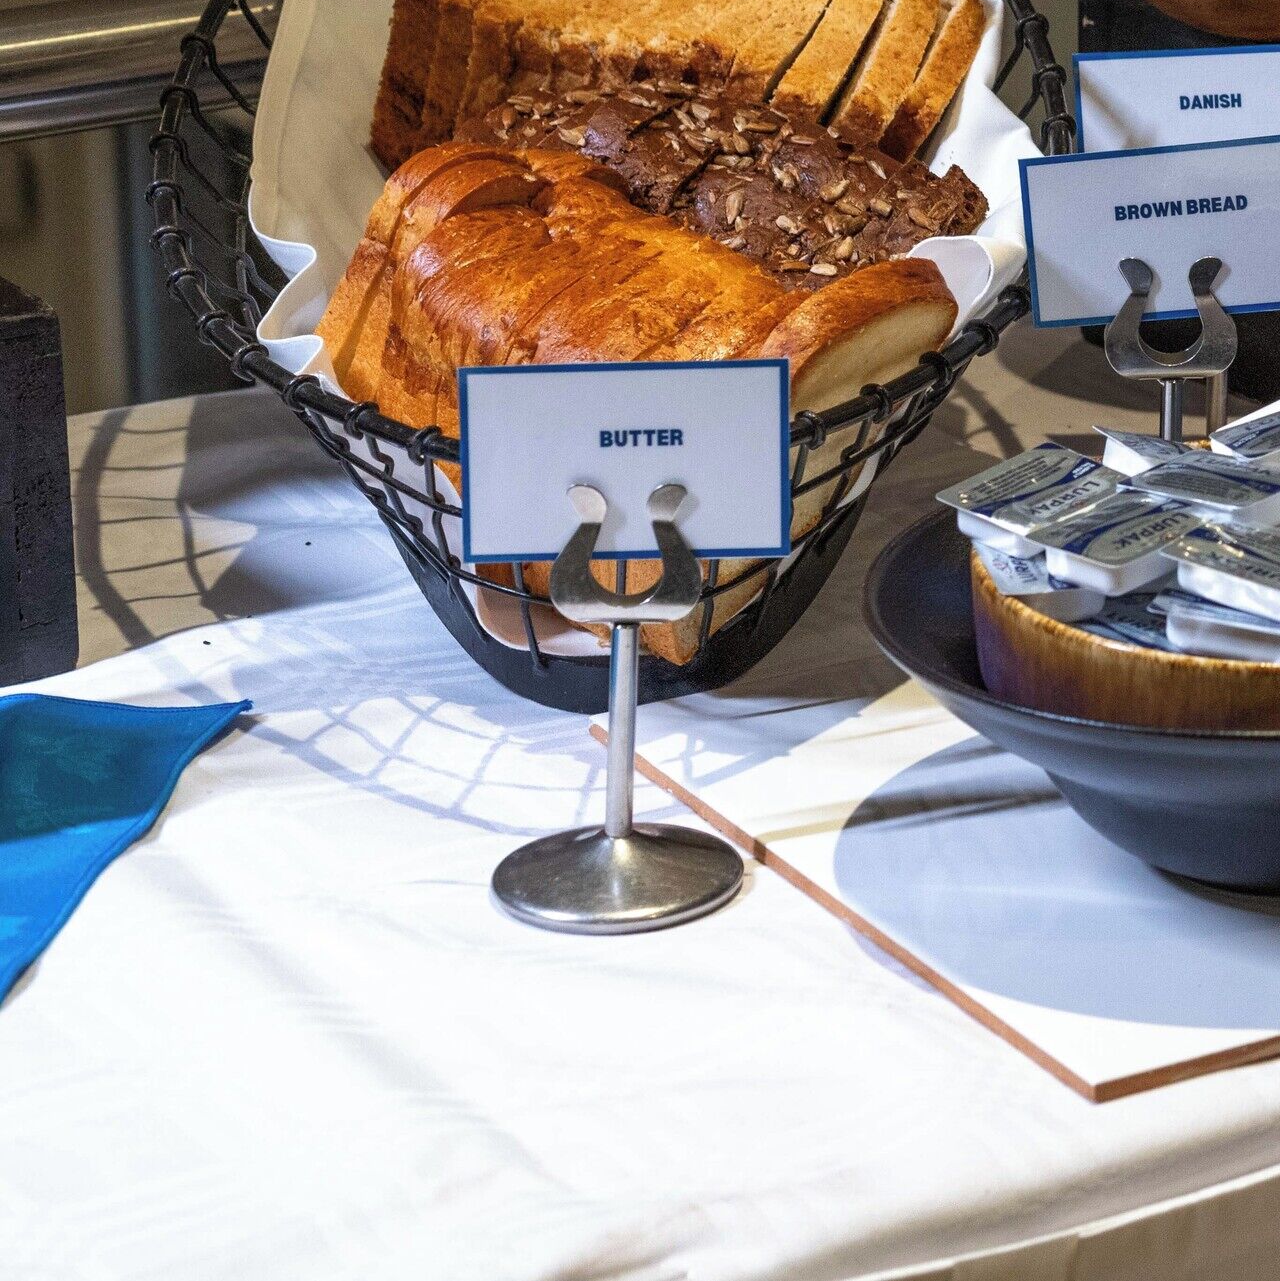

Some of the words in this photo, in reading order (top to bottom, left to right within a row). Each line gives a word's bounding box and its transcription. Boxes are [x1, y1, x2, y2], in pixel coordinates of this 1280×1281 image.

[1178, 93, 1243, 111] DANISH
[1114, 200, 1182, 221] BROWN
[1186, 195, 1248, 215] BREAD
[599, 428, 684, 448] BUTTER
[1029, 480, 1101, 516] LURPAK
[1112, 512, 1191, 548] LURPAK
